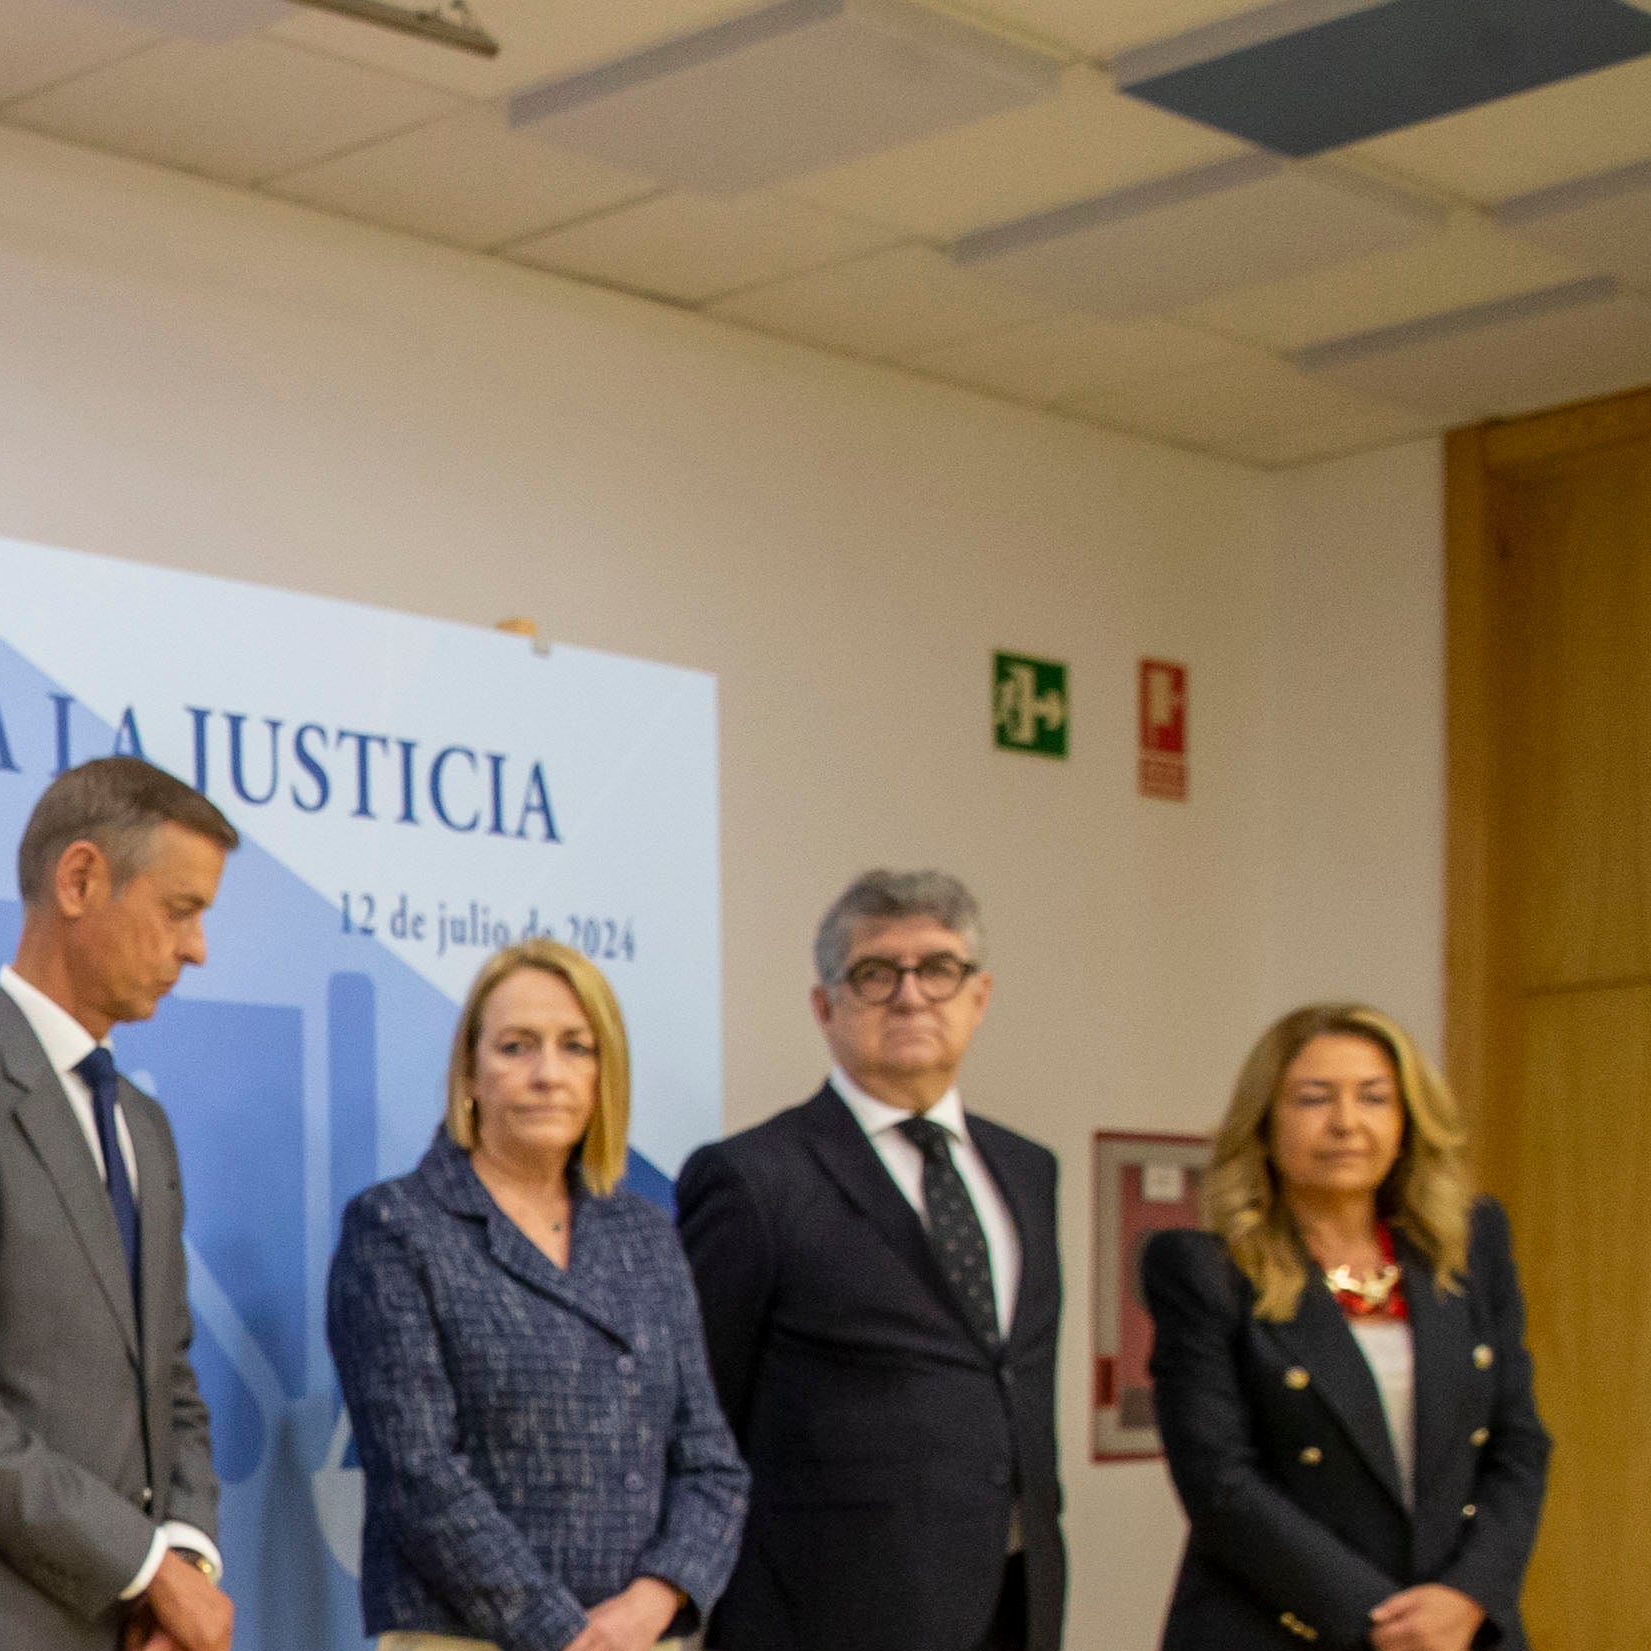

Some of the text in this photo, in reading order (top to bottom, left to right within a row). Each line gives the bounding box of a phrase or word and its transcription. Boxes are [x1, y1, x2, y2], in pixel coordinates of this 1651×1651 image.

[184, 705, 563, 844] JUSTICIA
[340, 890, 377, 936] 12
[388, 893, 426, 941] de
[436, 899, 512, 957] julio
[567, 911, 637, 962] 2024
